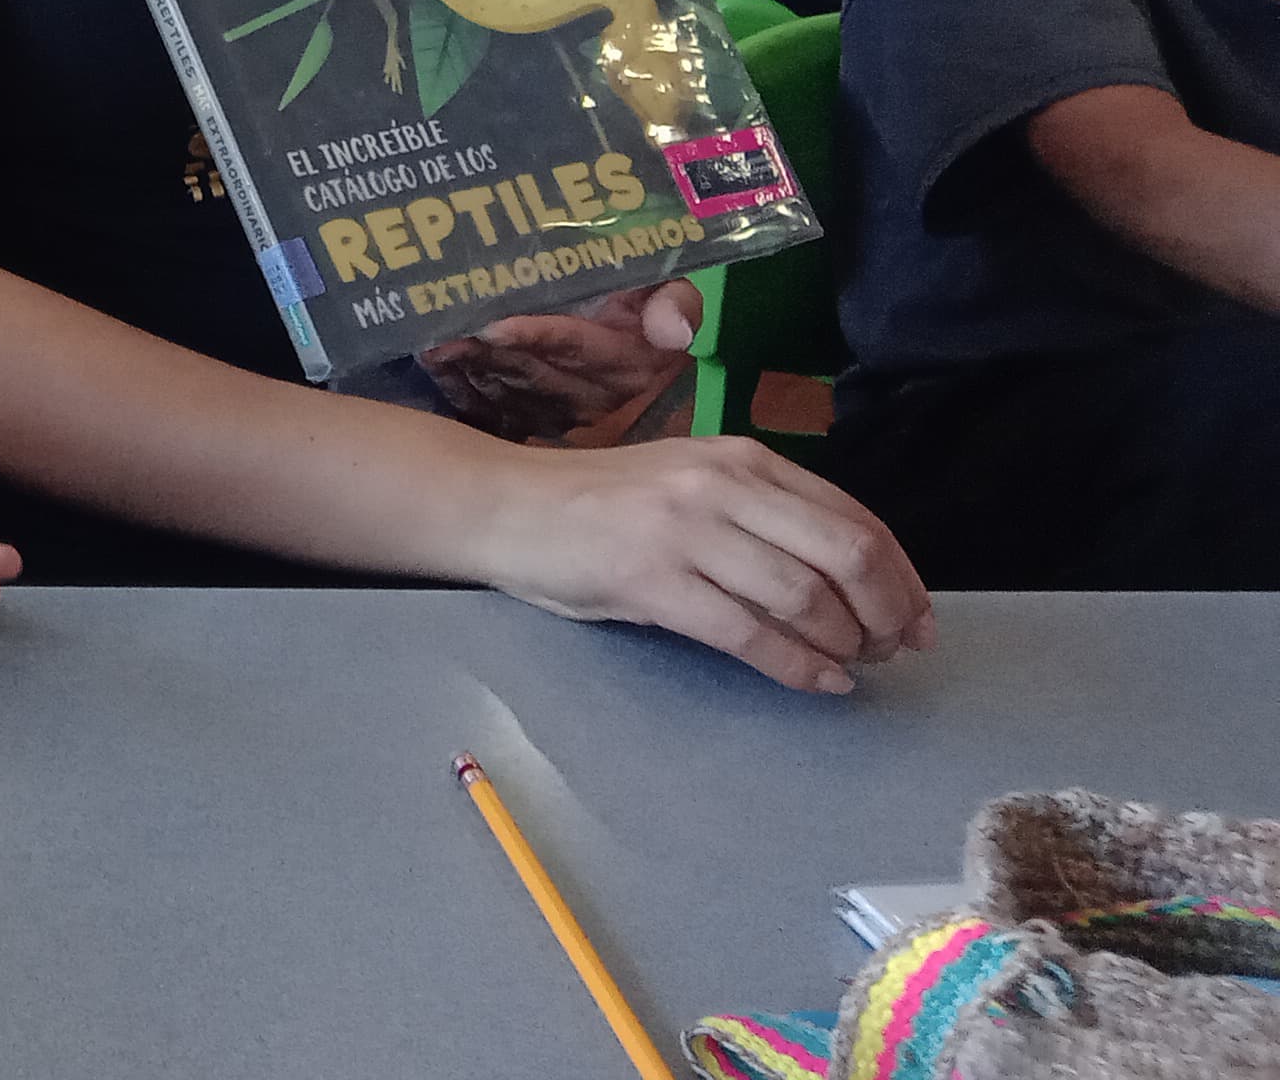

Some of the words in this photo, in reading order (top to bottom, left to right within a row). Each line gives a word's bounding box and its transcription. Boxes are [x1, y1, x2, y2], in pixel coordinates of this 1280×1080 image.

[286, 150, 319, 178] EL
[320, 118, 448, 171] INCREÍBLE
[303, 164, 418, 212] CATÁLOGO
[424, 156, 453, 186] DE
[458, 143, 498, 177] LOS
[318, 152, 646, 283] REPTILES
[352, 287, 406, 329] MÁS
[405, 216, 705, 316] EXTRAORDINARIOS
